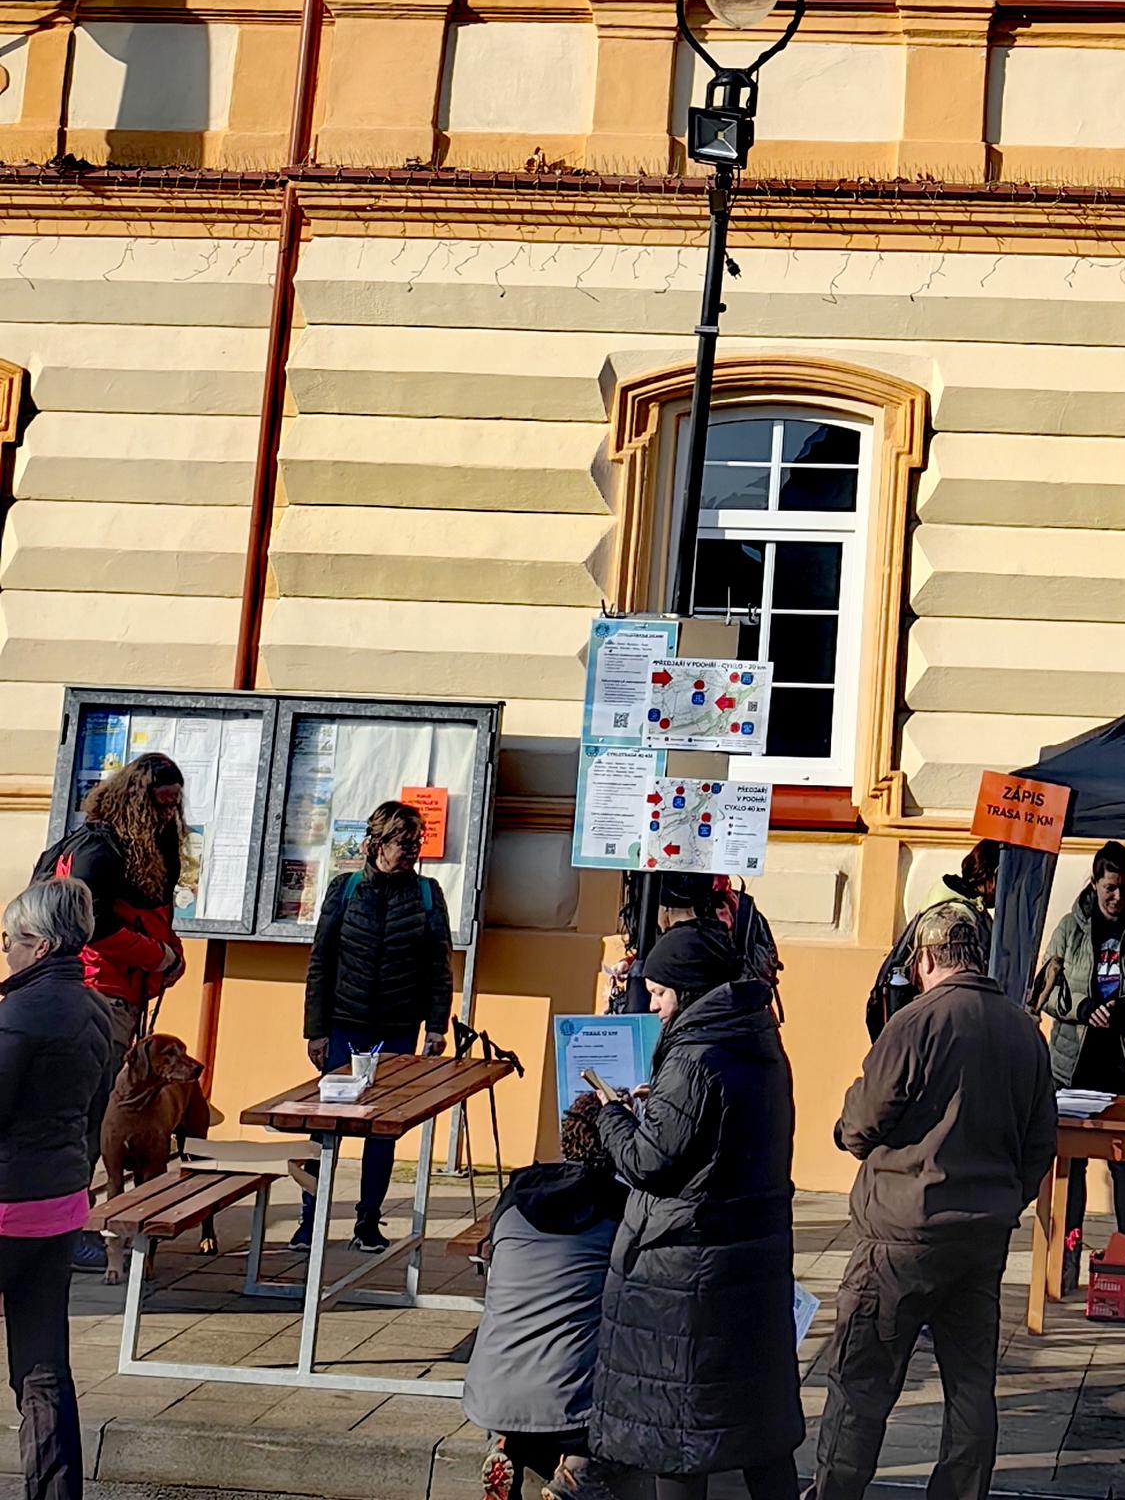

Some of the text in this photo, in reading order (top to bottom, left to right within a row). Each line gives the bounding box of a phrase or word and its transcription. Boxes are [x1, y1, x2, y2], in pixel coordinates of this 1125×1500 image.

[1002, 784, 1046, 807] ZÁPIS
[986, 803, 1054, 827] TRASA 12 KM
